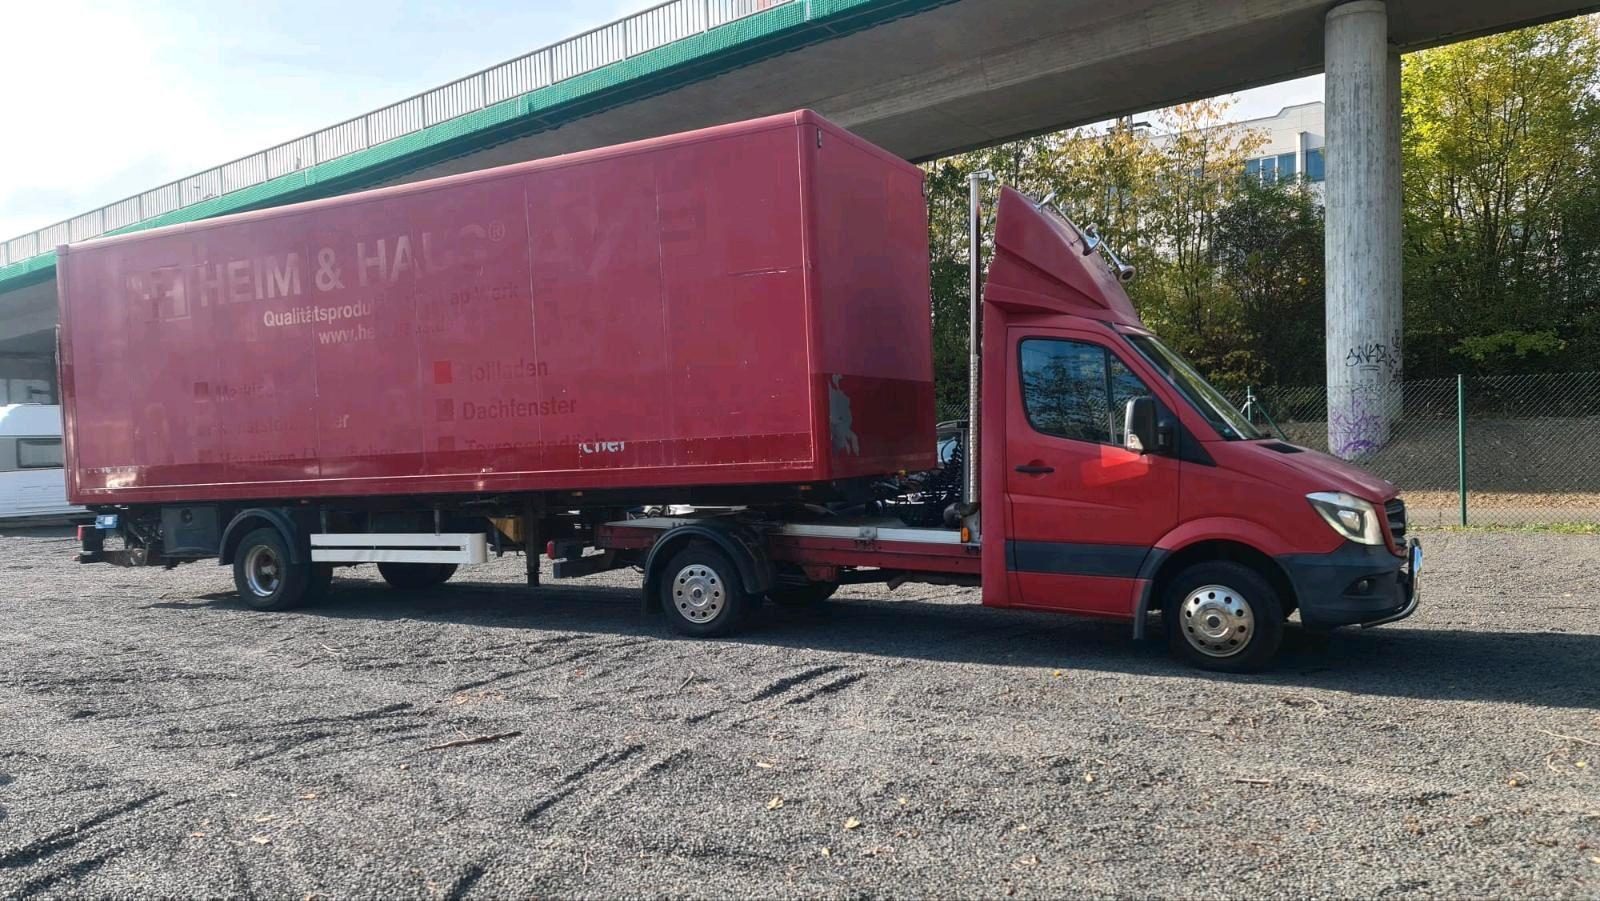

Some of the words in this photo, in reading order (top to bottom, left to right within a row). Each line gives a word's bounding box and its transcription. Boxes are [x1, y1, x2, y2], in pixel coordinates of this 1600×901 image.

[200, 252, 302, 306] HEIM
[314, 247, 346, 292] &
[462, 396, 577, 421] Dachfenster
